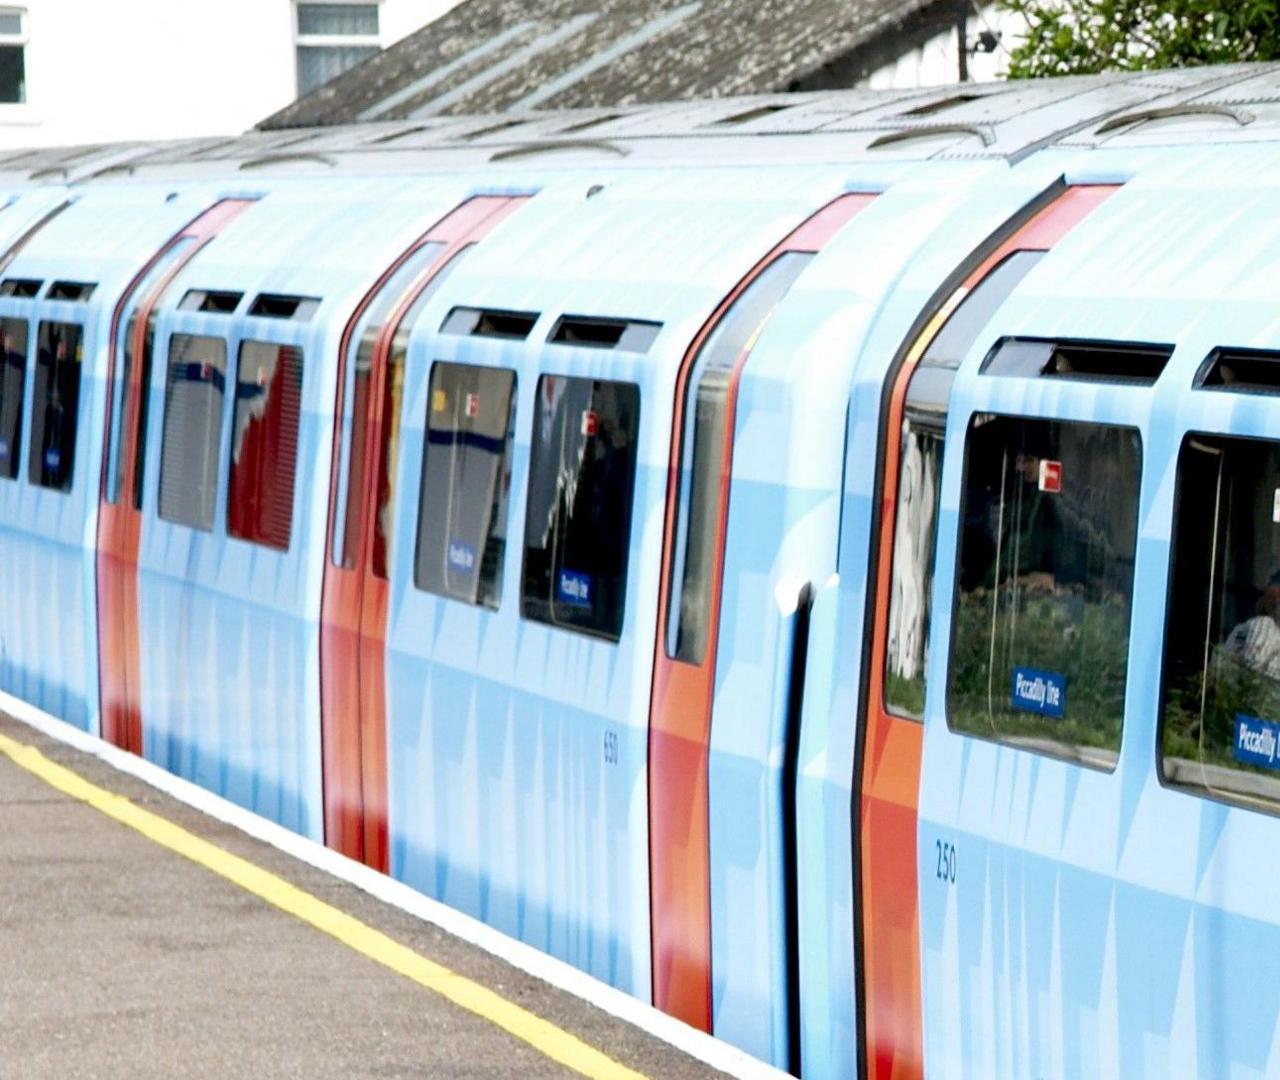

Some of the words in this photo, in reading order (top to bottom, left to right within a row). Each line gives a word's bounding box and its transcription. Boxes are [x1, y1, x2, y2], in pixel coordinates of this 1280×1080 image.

[1015, 672, 1046, 708] Piccadilly
[1046, 680, 1060, 706] line
[1238, 722, 1276, 763] Piccadilly
[936, 838, 956, 884] 250
